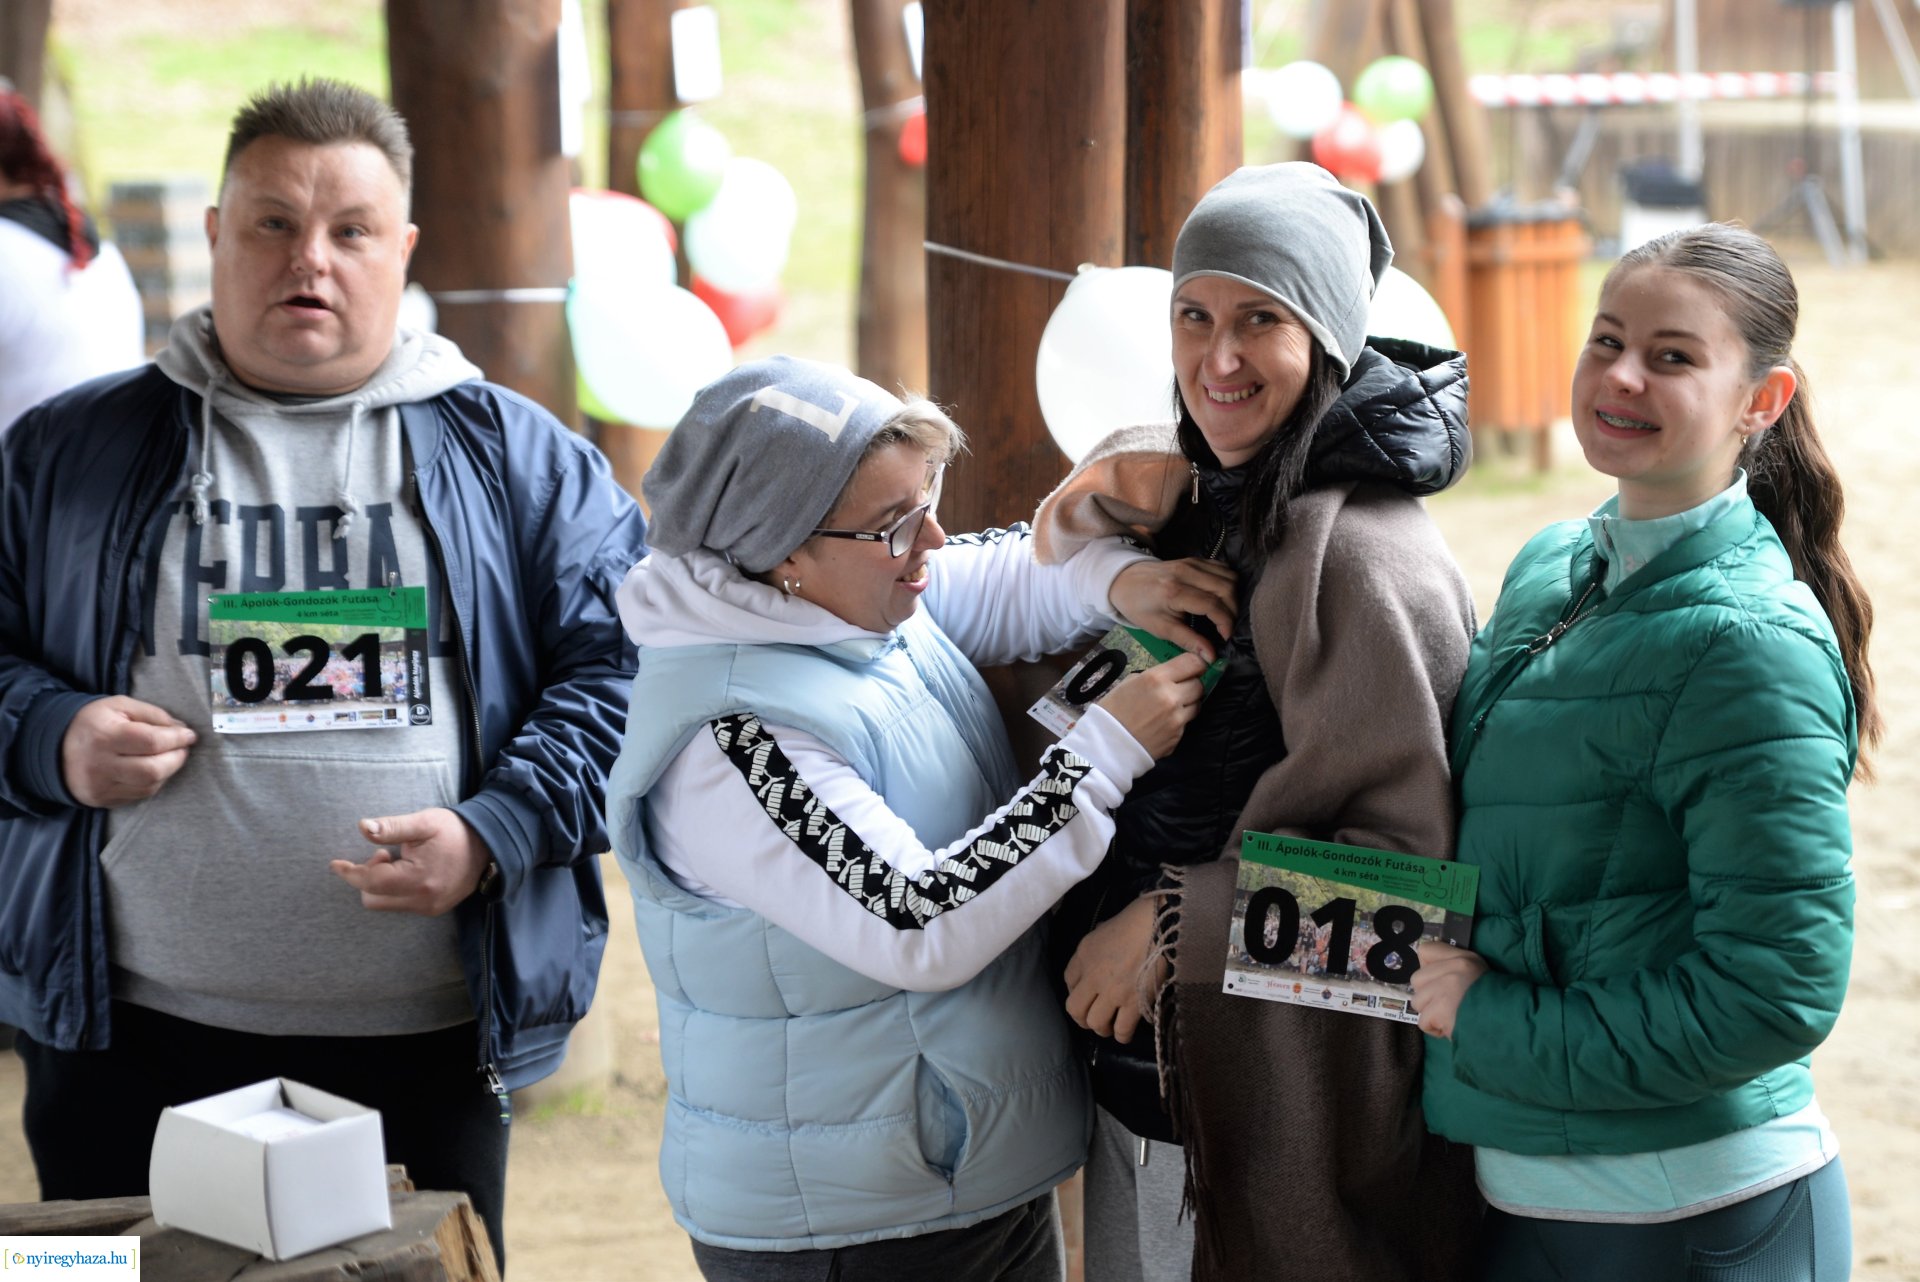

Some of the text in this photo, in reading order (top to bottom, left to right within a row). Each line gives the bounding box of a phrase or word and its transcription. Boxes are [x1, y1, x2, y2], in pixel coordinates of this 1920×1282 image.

[223, 593, 379, 609] III. Ápolók-Gondozók Futása
[296, 610, 302, 618] 4
[303, 610, 318, 618] km
[319, 608, 339, 618] séta
[225, 633, 383, 704] 021
[1065, 648, 1143, 706] 0
[1257, 839, 1425, 874] III. Ápolók-Gondozók Futása
[1333, 867, 1380, 882] 4 km séta
[1243, 886, 1425, 985] 018
